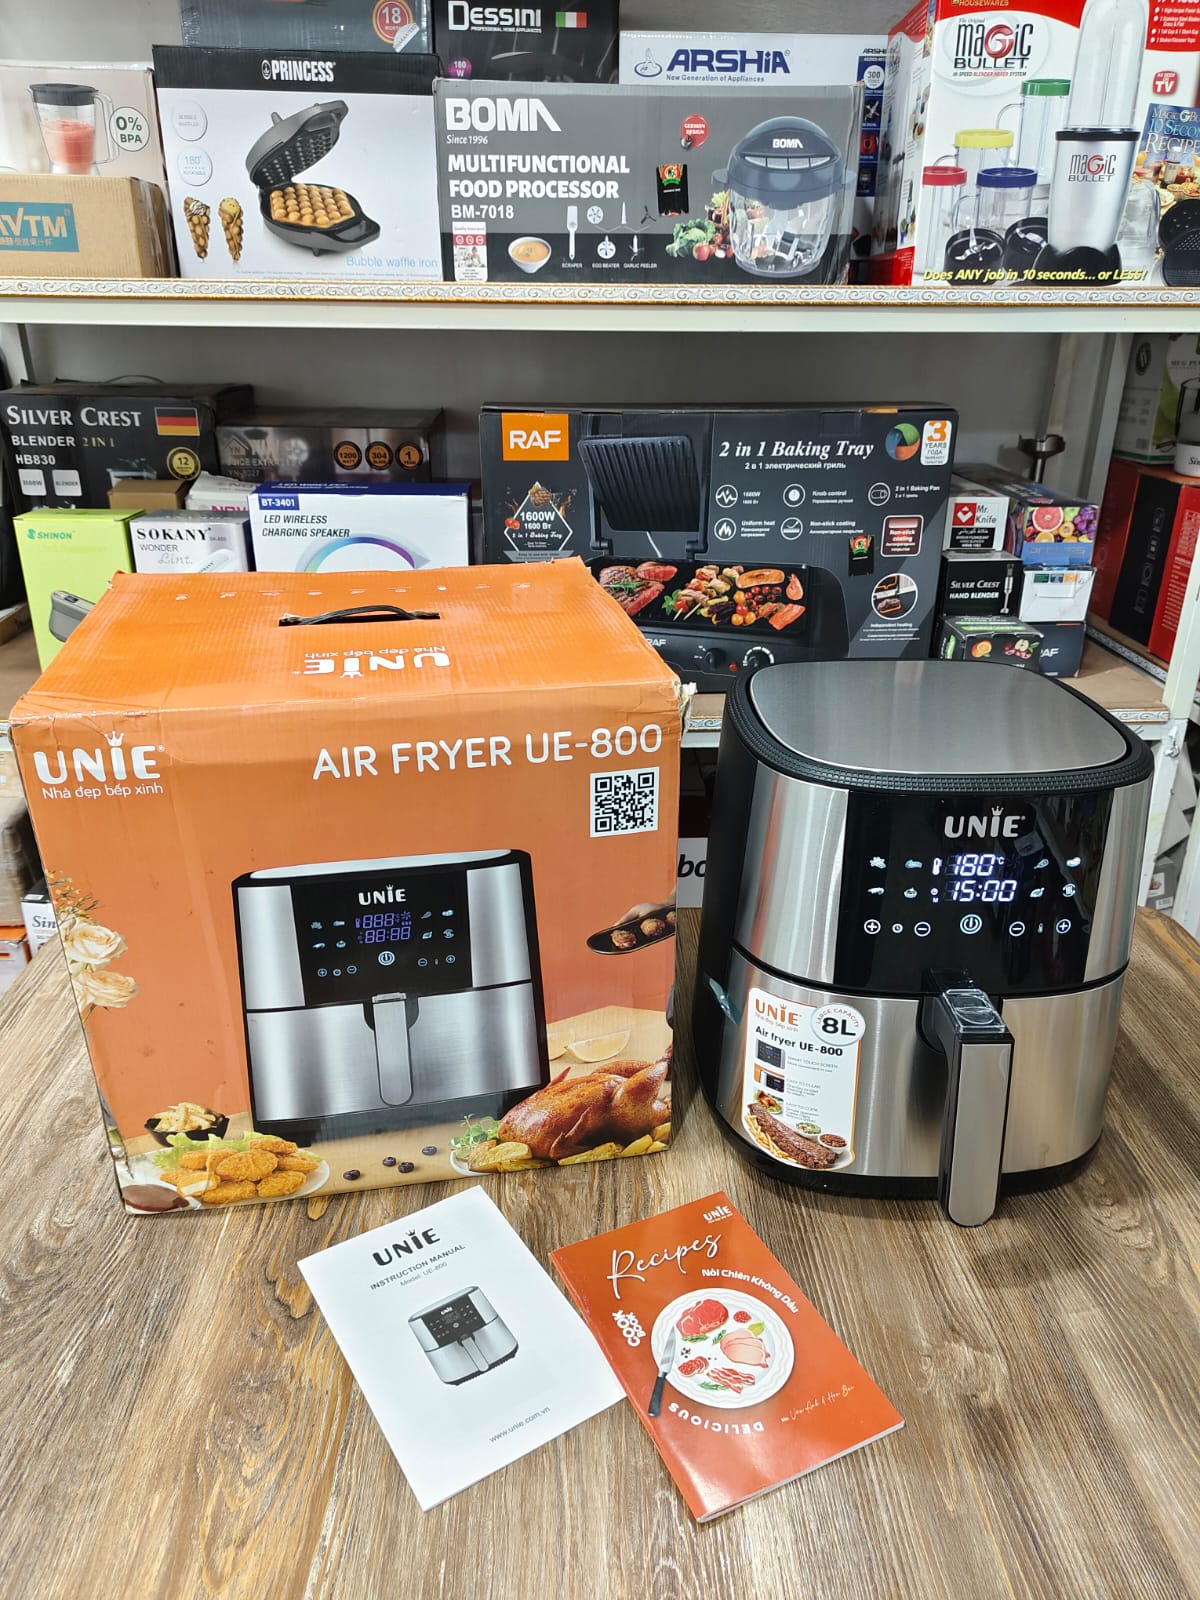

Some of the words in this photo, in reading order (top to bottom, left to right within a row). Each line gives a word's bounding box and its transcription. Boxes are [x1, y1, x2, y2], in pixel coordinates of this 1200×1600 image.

[382, 7, 401, 24] 18
[954, 57, 1031, 69] BULLET
[272, 60, 334, 82] PRINCESS
[457, 69, 465, 78] W
[728, 75, 765, 83] Appliances
[1155, 81, 1175, 92] TV
[116, 116, 143, 132] 0%
[120, 133, 143, 144] BPA
[446, 134, 468, 145] Since
[468, 135, 489, 145] 1996
[448, 154, 630, 174] MULTIFUNCTIONAL
[1067, 174, 1113, 183] BULLET
[449, 179, 503, 198] FOOD
[505, 180, 620, 199] PROCESSOR
[451, 204, 515, 219] BM-7018
[346, 255, 383, 267] Bubble
[386, 256, 416, 268] waffle
[418, 257, 438, 268] iron
[923, 269, 953, 281] Does
[955, 269, 984, 281] ANY
[984, 268, 1006, 282] job
[1006, 268, 1018, 280] in
[1022, 269, 1036, 281] 10
[1036, 269, 1096, 281] seconds...
[1098, 271, 1113, 281] or
[1113, 269, 1148, 281] LESS!
[6, 405, 73, 426] SILVER
[80, 407, 142, 427] CREST
[927, 419, 947, 442] 3
[12, 435, 76, 447] BLENDER
[83, 438, 90, 447] 2
[91, 438, 107, 447] IN
[509, 430, 561, 449] RAF
[405, 451, 412, 460] 1
[719, 441, 730, 457] 2
[735, 442, 752, 457] in
[757, 441, 766, 457] 1
[771, 440, 832, 460] Baking
[836, 440, 875, 460] Tray
[15, 454, 56, 465] HB830
[178, 457, 190, 465] 12
[764, 461, 822, 470] электрический
[823, 462, 847, 470] гриль
[261, 498, 295, 507] BT-3401
[520, 511, 555, 521] 1600W
[977, 505, 990, 514] Mr.
[264, 515, 281, 524] LED
[283, 515, 328, 525] WIRELESS
[524, 522, 541, 530] 1600
[976, 515, 997, 524] Knife
[37, 531, 72, 540] SHINON
[136, 527, 207, 541] SOKANY
[262, 527, 307, 538] CHARGING
[309, 528, 351, 538] SPEAKER
[530, 531, 549, 539] Baking
[550, 531, 562, 539] Tray
[140, 544, 178, 552] WONDER
[950, 580, 976, 589] SILVER
[976, 580, 1001, 589] CREST
[304, 651, 339, 659] xinh
[313, 746, 379, 781] AIR
[391, 735, 513, 775] FRYER
[525, 723, 663, 765] UE-800
[42, 787, 72, 800] Nhà
[75, 785, 102, 800] đẹp
[104, 783, 132, 798] bếp
[135, 783, 163, 795] xinh
[952, 880, 1018, 902] 15:00
[816, 1009, 832, 1026] LARGE
[833, 1008, 860, 1028] CAPACITY
[821, 1016, 857, 1037] 8L
[755, 1026, 769, 1037] Air
[771, 1032, 797, 1047] fryer
[800, 1042, 843, 1057] UE-800
[370, 1260, 429, 1290] INSTRUCTION
[429, 1243, 466, 1263] MANUAL
[606, 1233, 723, 1300] Recipes
[721, 1269, 751, 1282] Chiên
[750, 1275, 783, 1300] Không
[611, 1309, 641, 1347] COOK
[667, 1401, 765, 1435] DELICIOUS
[489, 1407, 551, 1444] www.unie.com.vn
